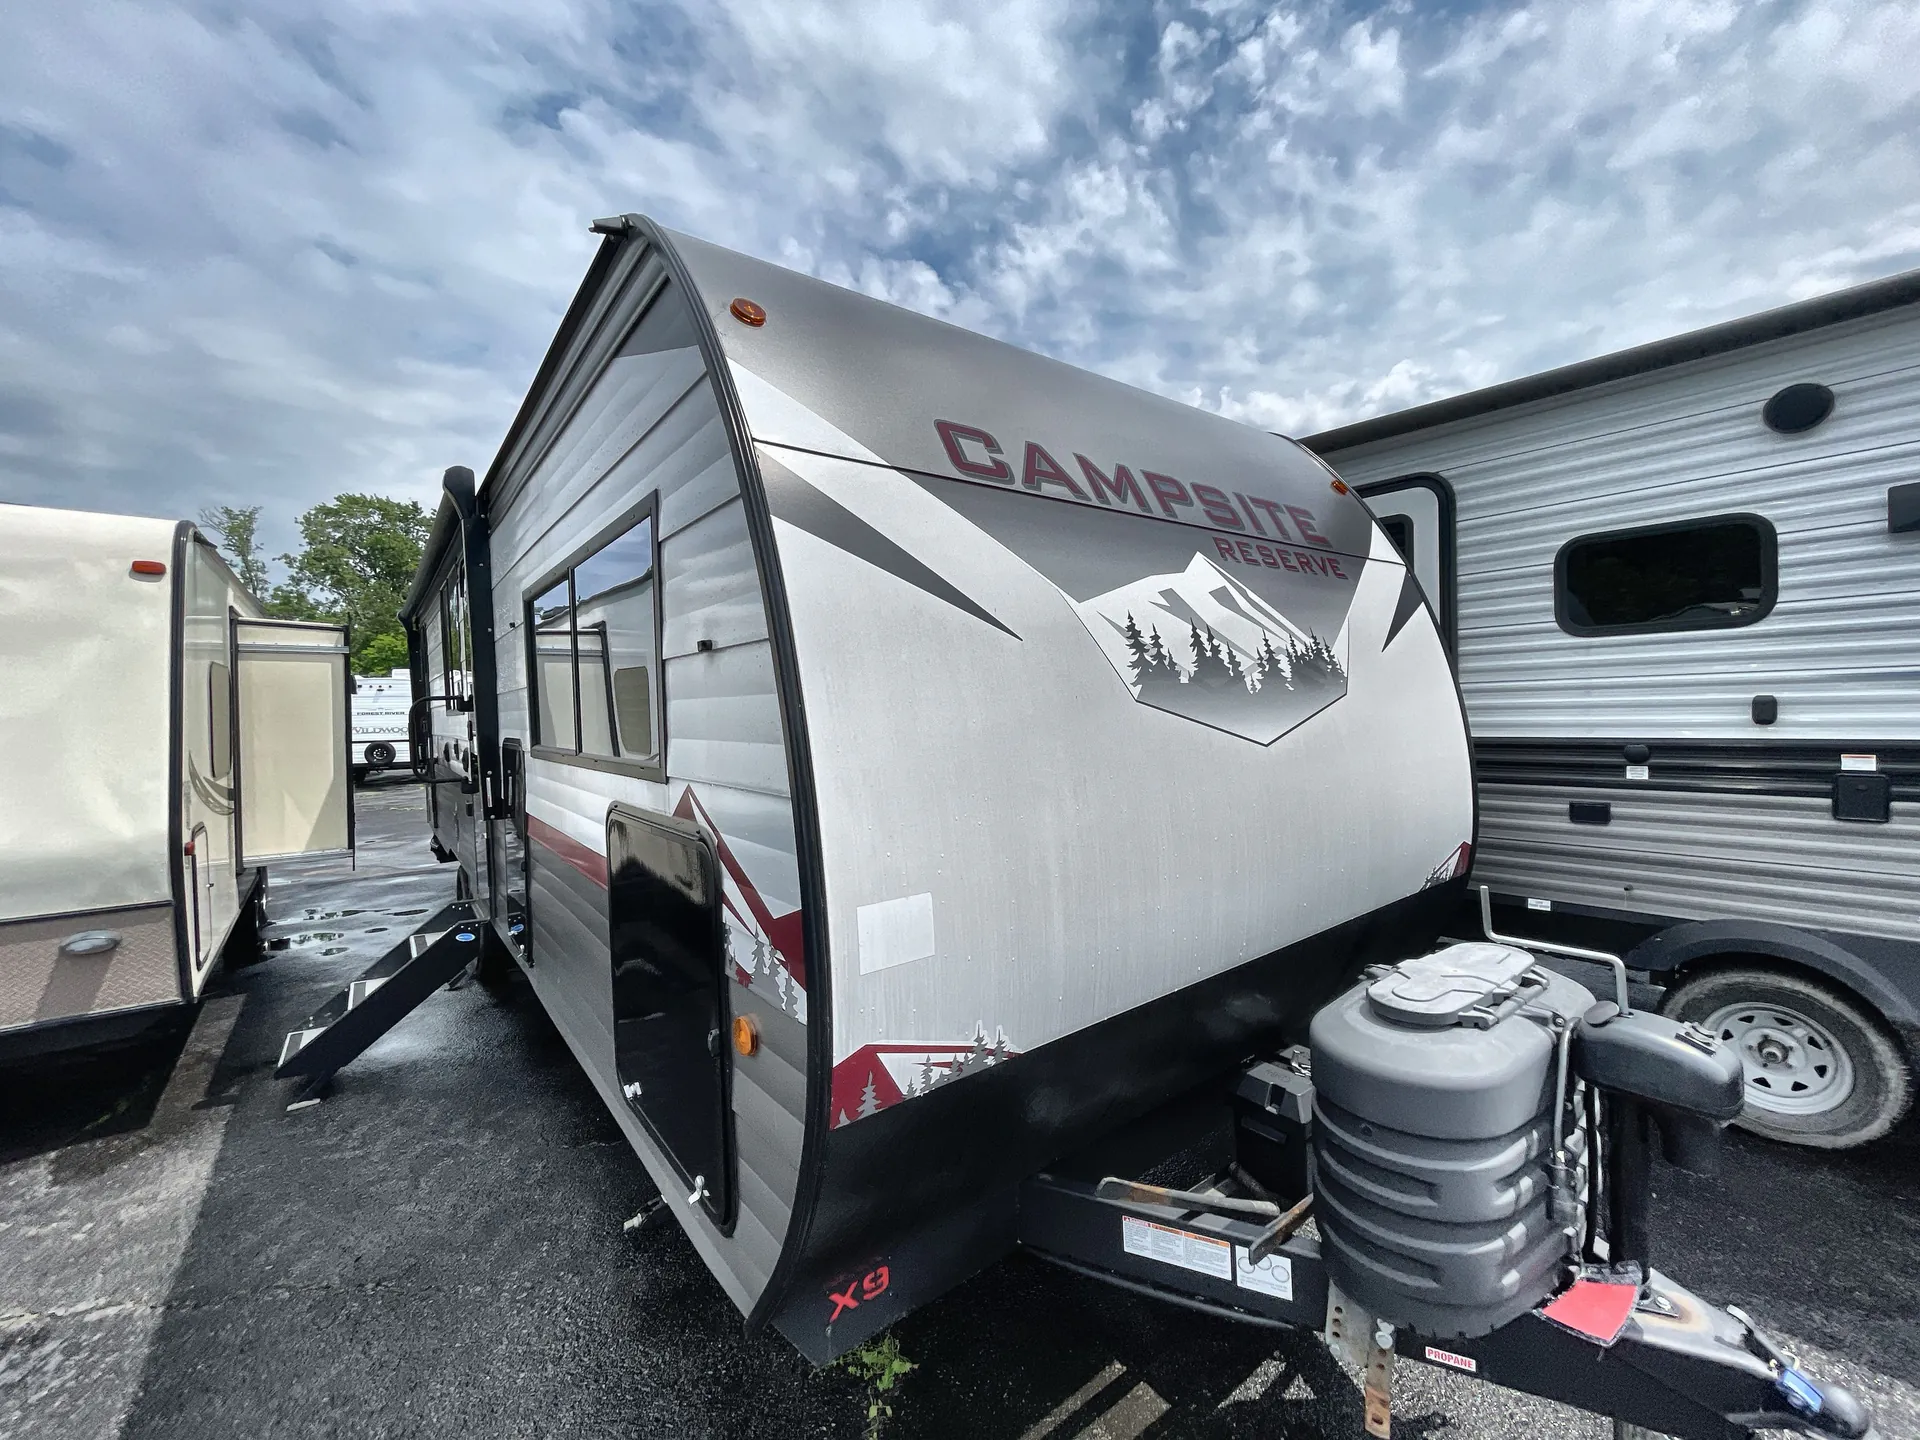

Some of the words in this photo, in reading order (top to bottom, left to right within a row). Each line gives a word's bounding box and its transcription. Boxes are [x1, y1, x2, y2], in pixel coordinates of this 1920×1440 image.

[933, 418, 1333, 548] CAMPSITE
[1212, 535, 1349, 580] RESERVE
[828, 1265, 890, 1324] X9
[1427, 1348, 1475, 1369] PROPANE
